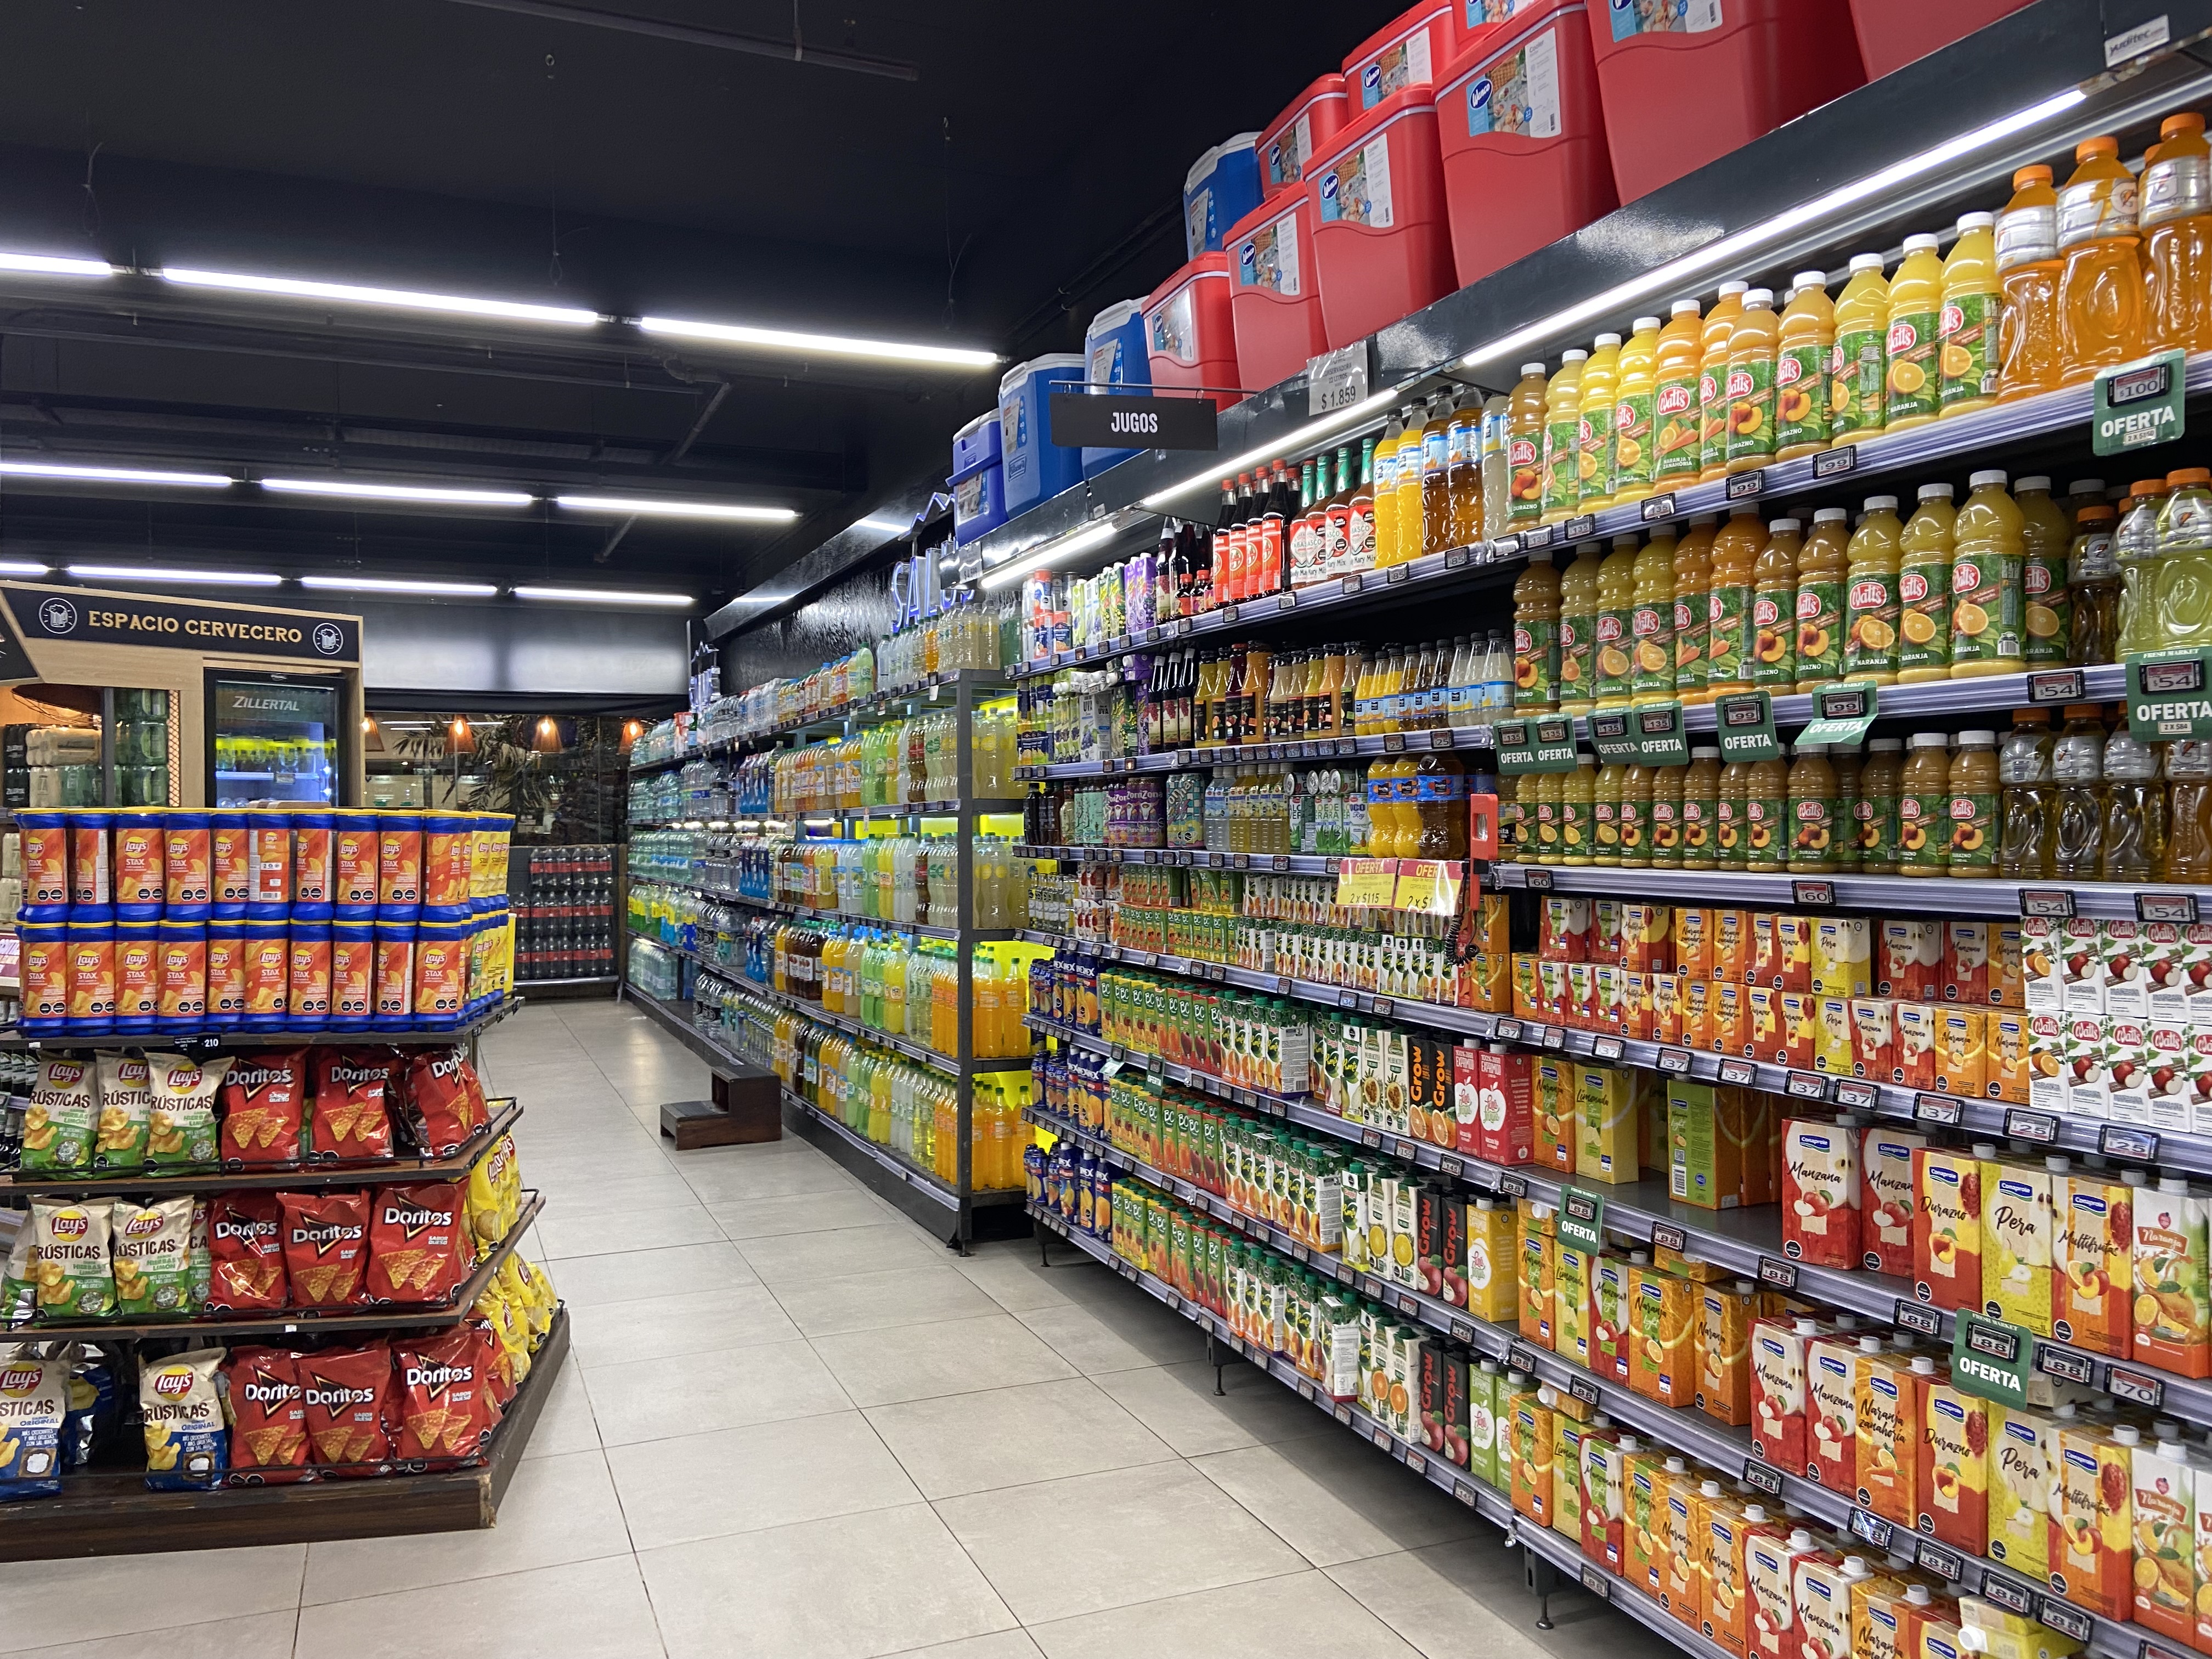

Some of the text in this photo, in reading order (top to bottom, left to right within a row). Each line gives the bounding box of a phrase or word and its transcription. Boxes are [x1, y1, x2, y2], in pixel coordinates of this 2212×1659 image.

[1473, 83, 1491, 108] Wenco
[1324, 178, 1338, 198] Wenco
[1322, 386, 1356, 409] $ 1.859
[2120, 381, 2158, 397] $100
[1660, 389, 1688, 411] Watt's
[1891, 402, 1918, 411] NARANJA
[1111, 413, 1158, 433] JUGOS
[2101, 406, 2176, 438] OFERTA
[1663, 461, 1693, 470] ZANAHORIA
[1852, 585, 1885, 607] Watt's
[88, 610, 302, 643] ESPACIO CERVECERO
[1902, 652, 1928, 661] NARANJA
[2144, 651, 2166, 659] FRESH
[232, 695, 300, 712] ZILLERTAL
[2137, 701, 2212, 721] OFERTA
[1808, 719, 1865, 734] OFERTA
[1598, 742, 1638, 754] OFERTA
[1641, 739, 1683, 753] OFERTA
[1724, 734, 1771, 750] OFERTA
[1500, 752, 1534, 764] OFERTA
[1538, 748, 1573, 761] OFERTA
[1362, 893, 1379, 903] $115
[225, 1066, 294, 1086] Doritos
[331, 1066, 390, 1082] Doritos
[29, 1090, 90, 1108] RÚSTICAS
[151, 1095, 212, 1110] RÚSTICAS
[1787, 1161, 1843, 1184] Manzana
[1866, 1170, 1914, 1190] Manzan
[385, 1207, 452, 1227] Doritos
[1920, 1195, 1968, 1221] Durazno
[1995, 1206, 2038, 1235] Pera
[293, 1224, 362, 1244] Doritos
[1561, 1220, 1596, 1243] OFERTA
[2143, 1227, 2183, 1249] Naranja
[37, 1244, 101, 1260] RÚSTICAS
[407, 1365, 473, 1386] Doritos
[1756, 1363, 1793, 1390] Manzana
[1959, 1356, 2022, 1391] OFERTA
[306, 1385, 375, 1404] Doritos
[1810, 1383, 1854, 1410] Manzana
[0, 1399, 55, 1416] STICAS
[144, 1402, 210, 1422] RÚSTICAS
[1860, 1400, 1904, 1426] Naranja
[20, 1418, 59, 1426] ORIGINAL
[182, 1421, 215, 1431] ORIGINAL
[1923, 1428, 1971, 1457] Durazno
[2001, 1448, 2040, 1479] Pera
[1662, 1521, 1693, 1549] Naranja
[1704, 1548, 1737, 1576] Naranja
[1750, 1576, 1788, 1607] Manzana
